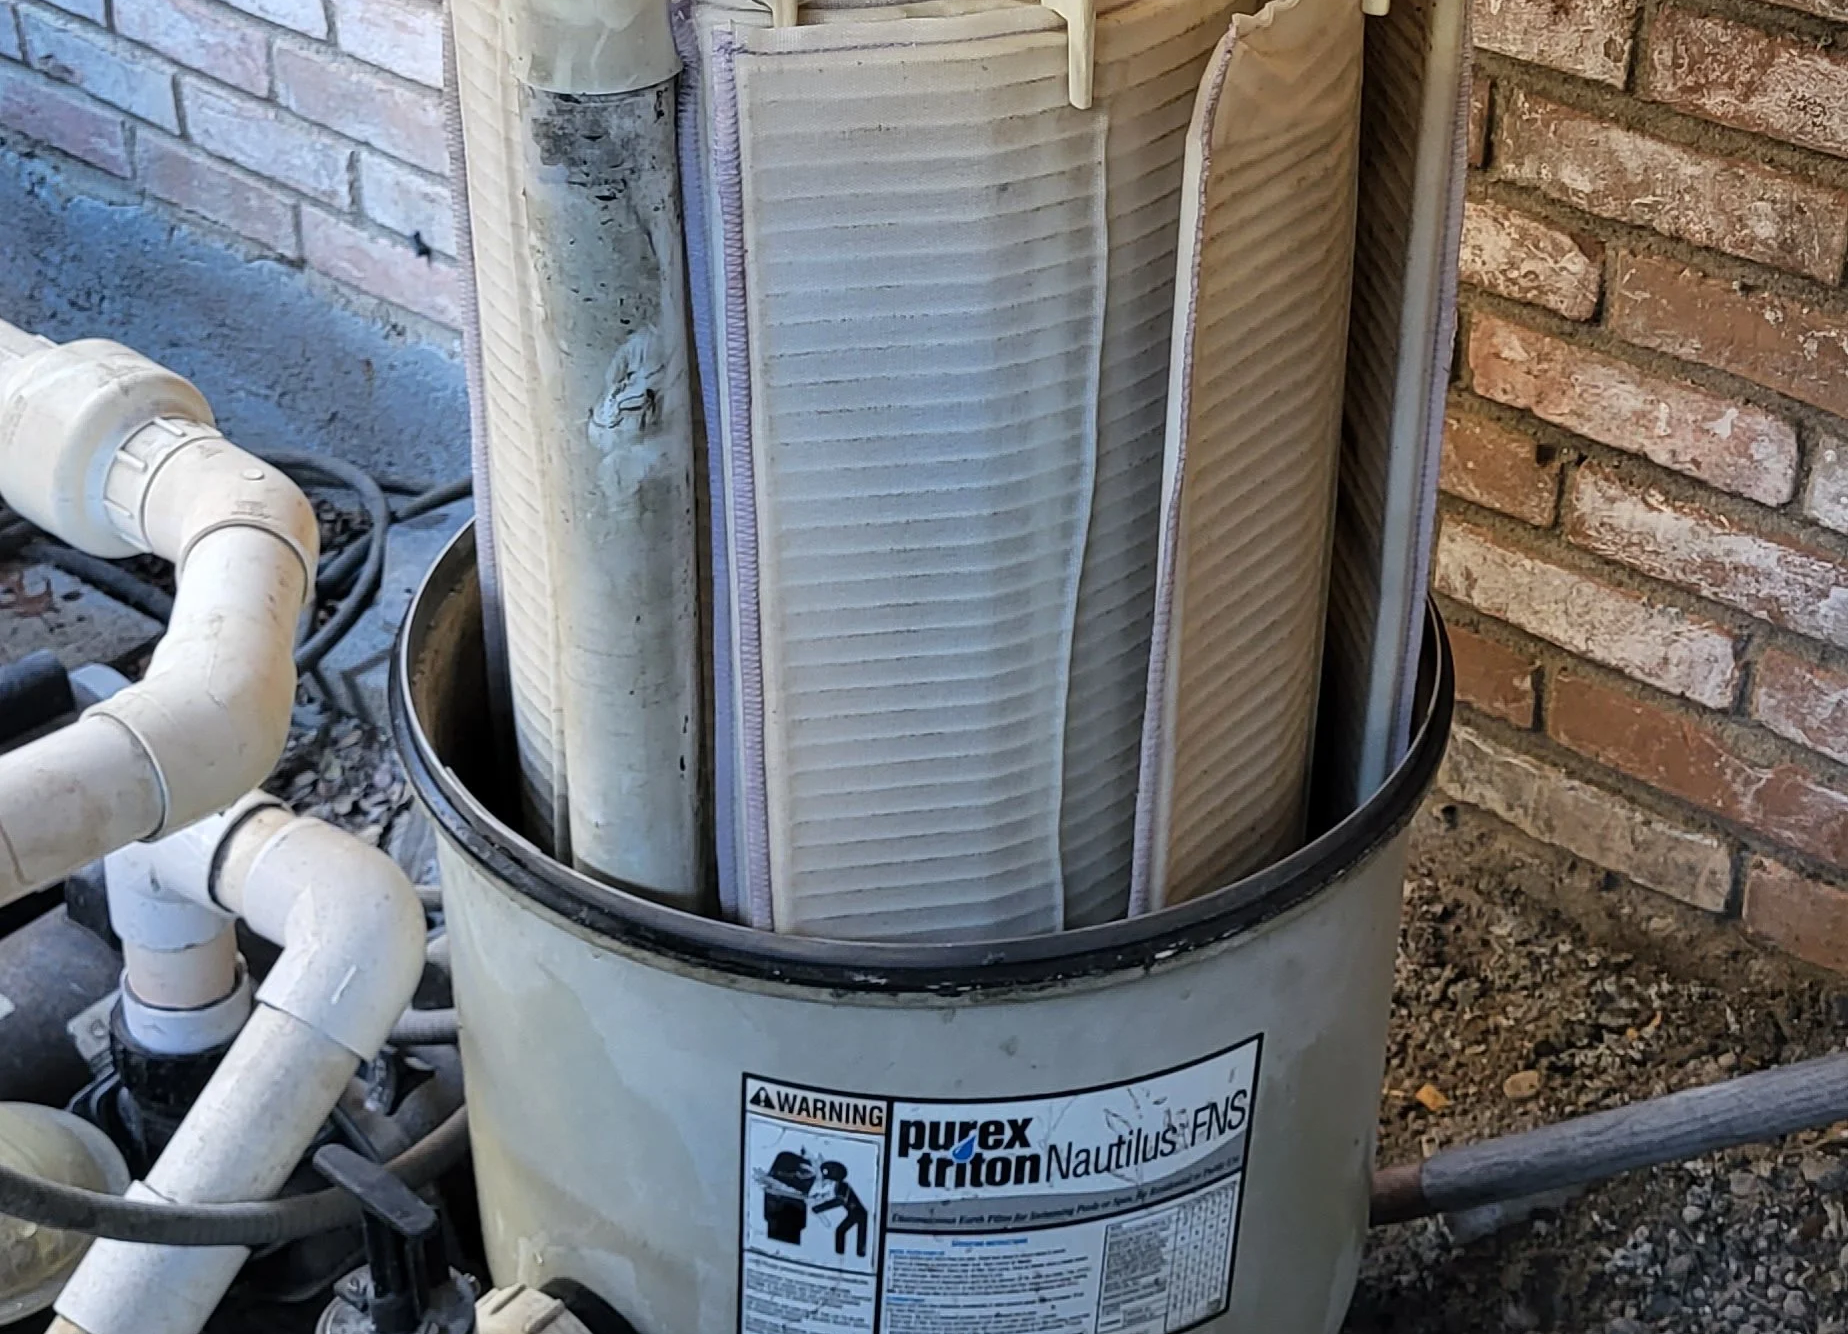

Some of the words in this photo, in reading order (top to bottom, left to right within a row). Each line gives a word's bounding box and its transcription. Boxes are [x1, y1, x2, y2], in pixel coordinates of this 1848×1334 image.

[776, 1090, 883, 1128] WARNING
[898, 1117, 1033, 1158] purex
[1046, 1127, 1178, 1182] Nautilus
[1190, 1089, 1248, 1147] FNS
[917, 1152, 1041, 1188] triton
